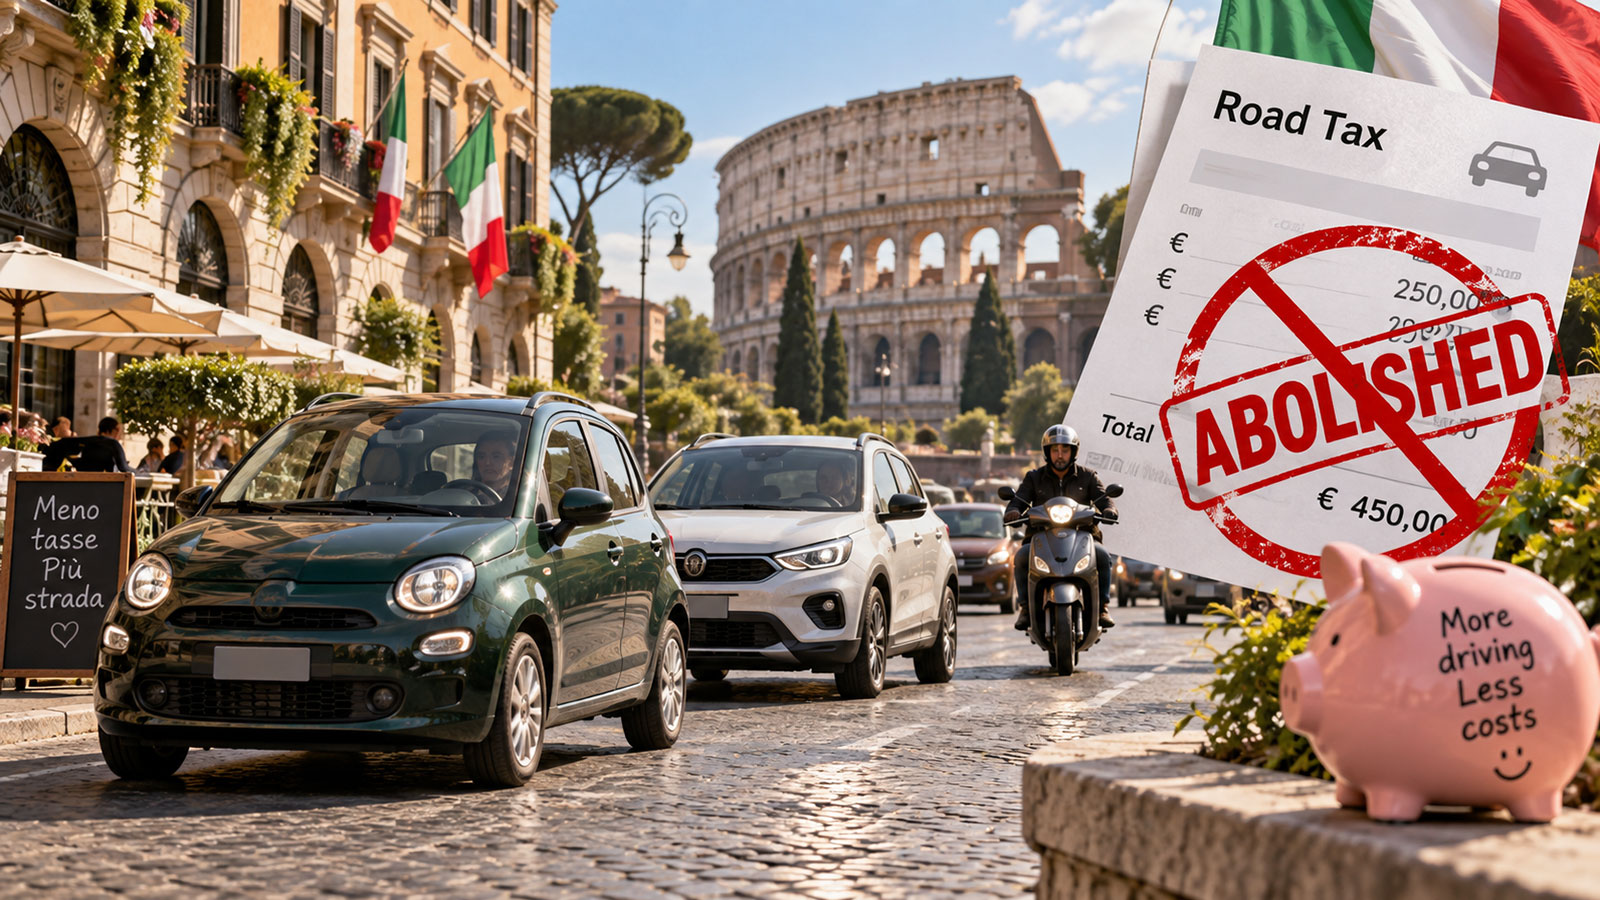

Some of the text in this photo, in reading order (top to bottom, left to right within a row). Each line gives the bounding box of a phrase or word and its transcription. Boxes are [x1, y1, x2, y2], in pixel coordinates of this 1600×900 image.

[1213, 89, 1387, 151] Road Tax
[1169, 232, 1189, 254] €
[1156, 268, 1177, 290] €
[1143, 304, 1164, 326] €
[1101, 413, 1155, 443] Total
[33, 494, 100, 521] Meno
[1317, 487, 1339, 511] €
[31, 527, 99, 551] tasse
[42, 556, 83, 582] Più
[24, 583, 105, 610] strada
[1440, 606, 1513, 638] More
[1438, 637, 1535, 674] driving
[1457, 675, 1524, 707] Less
[1461, 703, 1538, 741] costs
